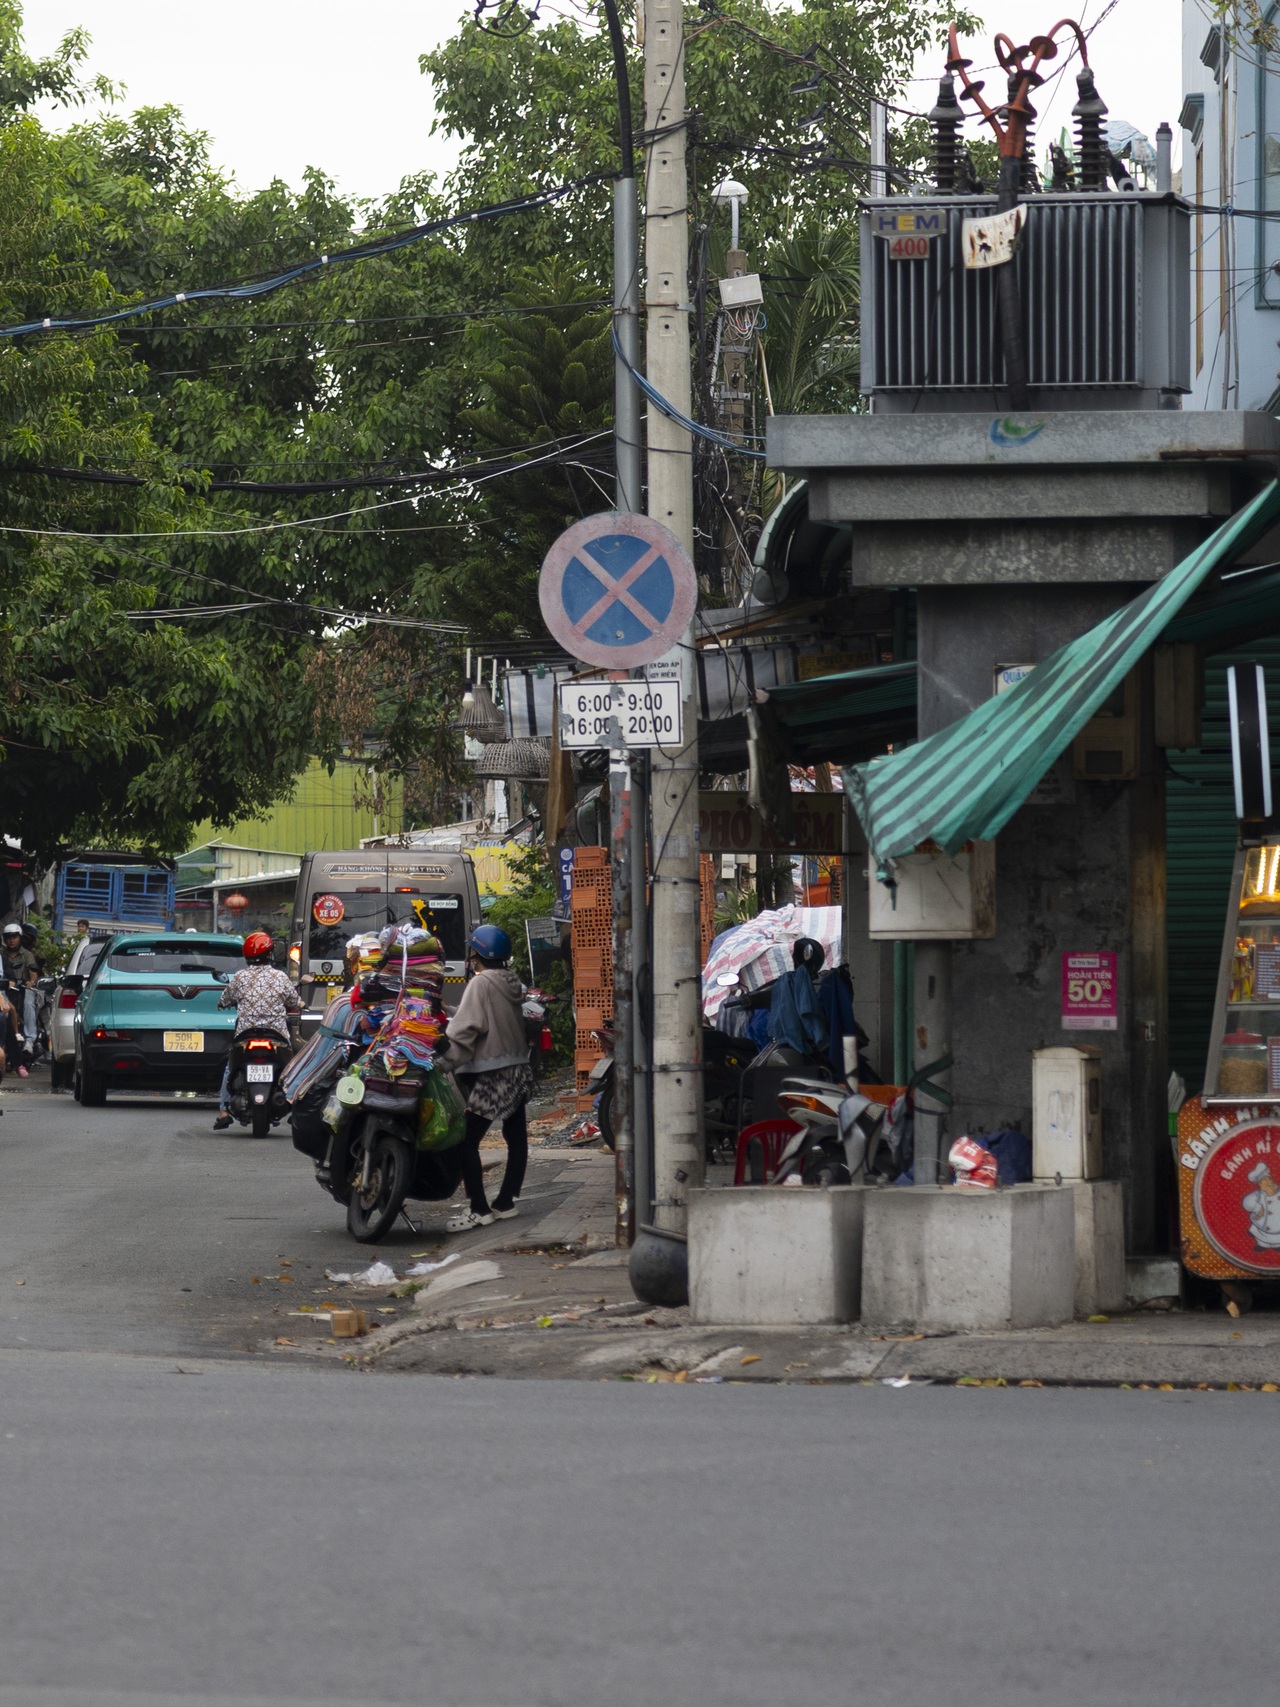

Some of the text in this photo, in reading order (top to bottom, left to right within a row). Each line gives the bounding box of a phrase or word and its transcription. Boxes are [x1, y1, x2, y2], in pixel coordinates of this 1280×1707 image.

[879, 214, 939, 231] HEM
[892, 237, 928, 257] 400
[578, 694, 612, 713] 6:00
[628, 692, 663, 712] 9:00
[628, 715, 673, 735] 20:00
[319, 909, 339, 917] XE 05
[1068, 970, 1091, 979] HOÀN
[175, 1032, 193, 1042] 50H
[168, 1041, 200, 1051] 776.47
[248, 1074, 272, 1082] 242.87
